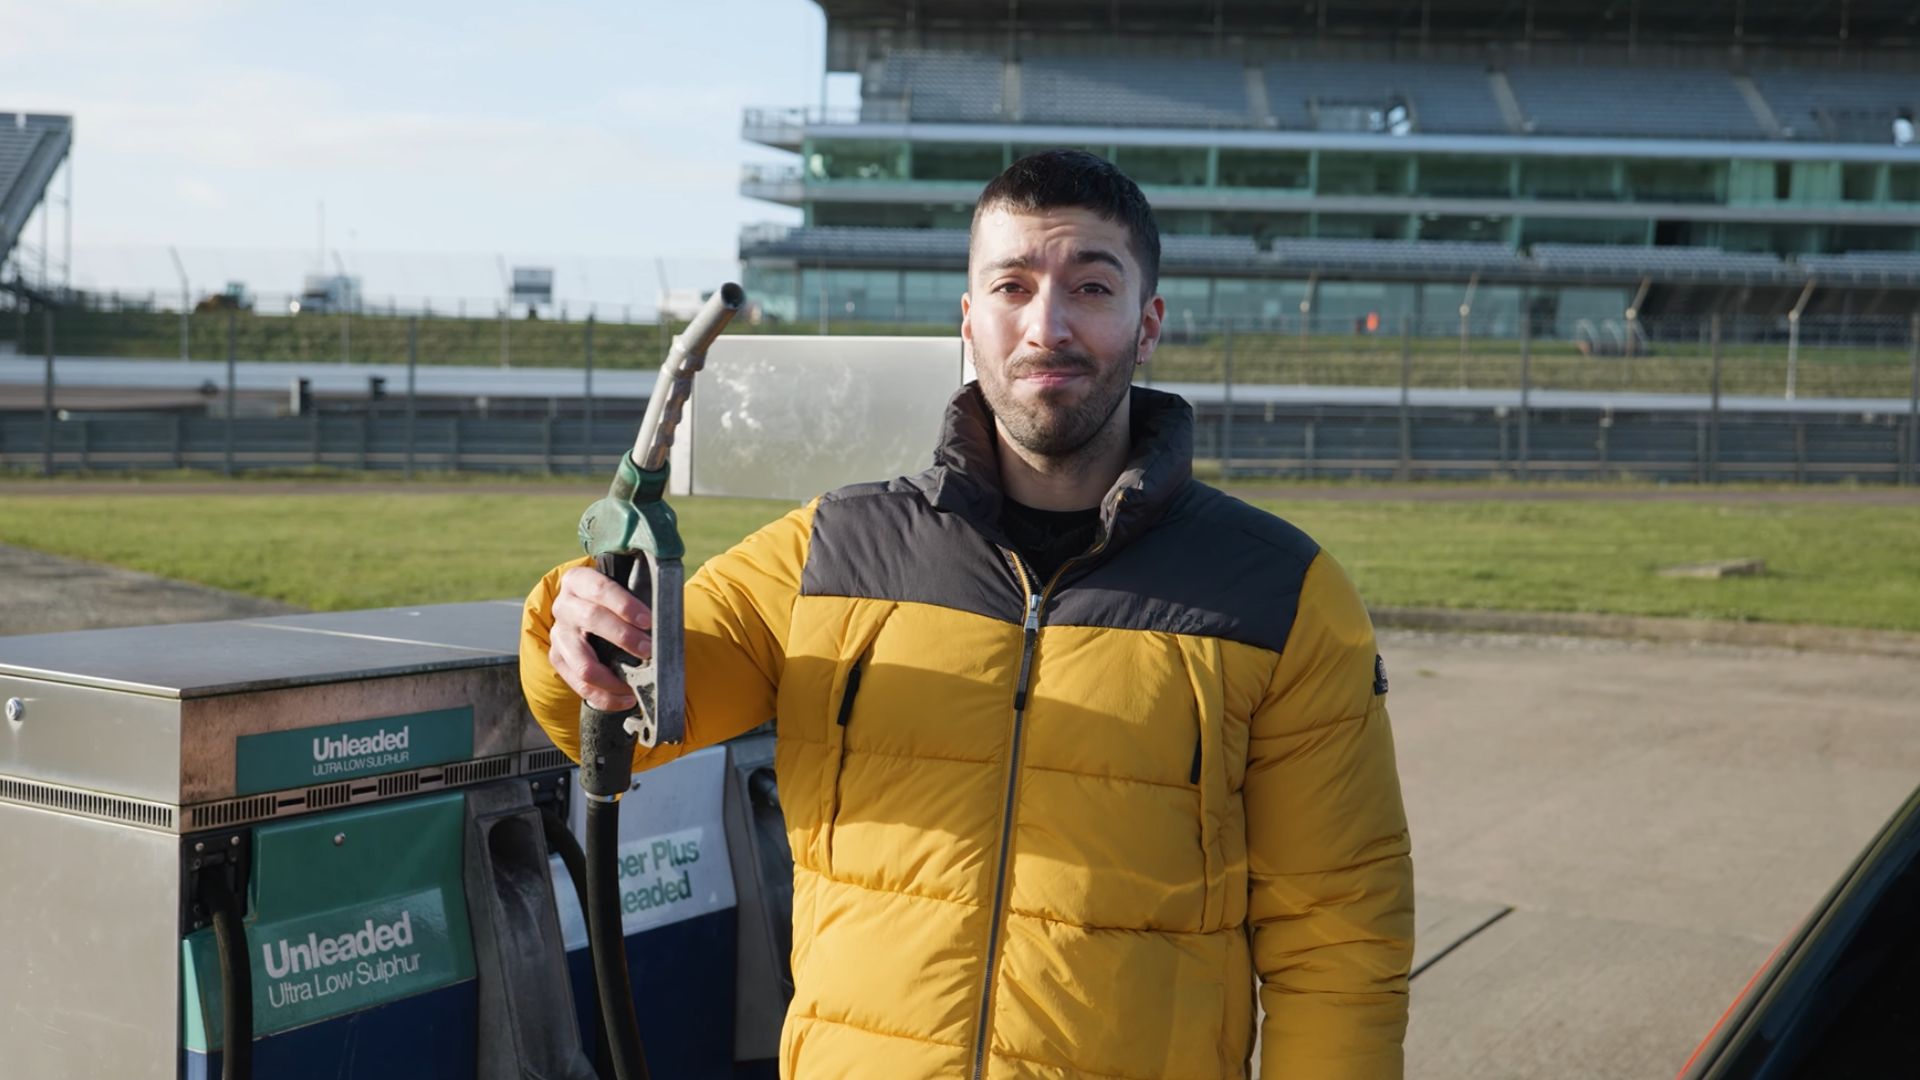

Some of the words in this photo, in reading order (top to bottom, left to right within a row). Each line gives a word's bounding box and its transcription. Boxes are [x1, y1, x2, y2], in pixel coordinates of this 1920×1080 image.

[313, 726, 409, 761] Unleaded
[313, 761, 342, 776] ULTRA
[343, 758, 366, 772] LOW
[366, 751, 410, 768] SULPHUR
[651, 839, 700, 871] Plus
[622, 869, 692, 915] eaded
[262, 910, 414, 979] Unleaded
[268, 980, 313, 1009] Ultra
[314, 970, 353, 997] Low
[356, 953, 421, 985] Sulphur
